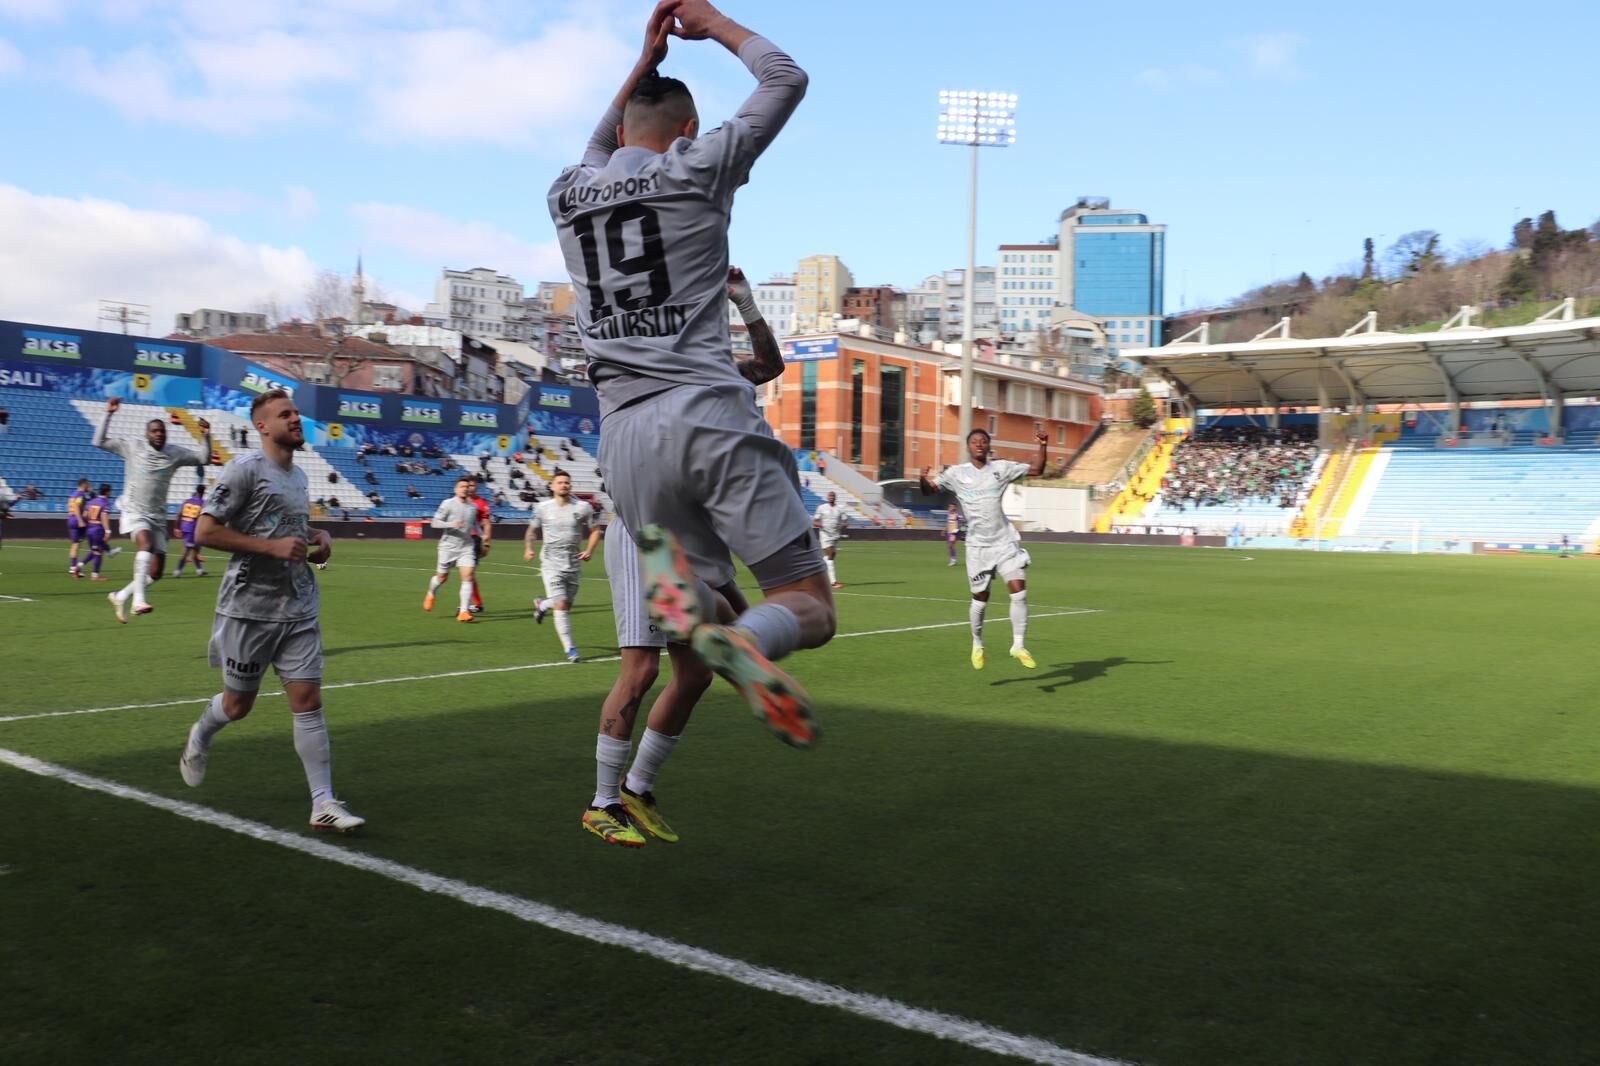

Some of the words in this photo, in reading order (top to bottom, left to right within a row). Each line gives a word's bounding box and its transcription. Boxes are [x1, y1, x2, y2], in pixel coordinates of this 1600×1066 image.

[567, 172, 661, 205] AUTOPORT
[573, 202, 673, 323] 19
[599, 304, 687, 340] DURSUN
[24, 337, 80, 354] aksa
[136, 349, 185, 365] aksa
[340, 400, 381, 414] aksa
[403, 406, 441, 419] aksa
[461, 411, 497, 424] aksa
[226, 656, 261, 673] nuh
